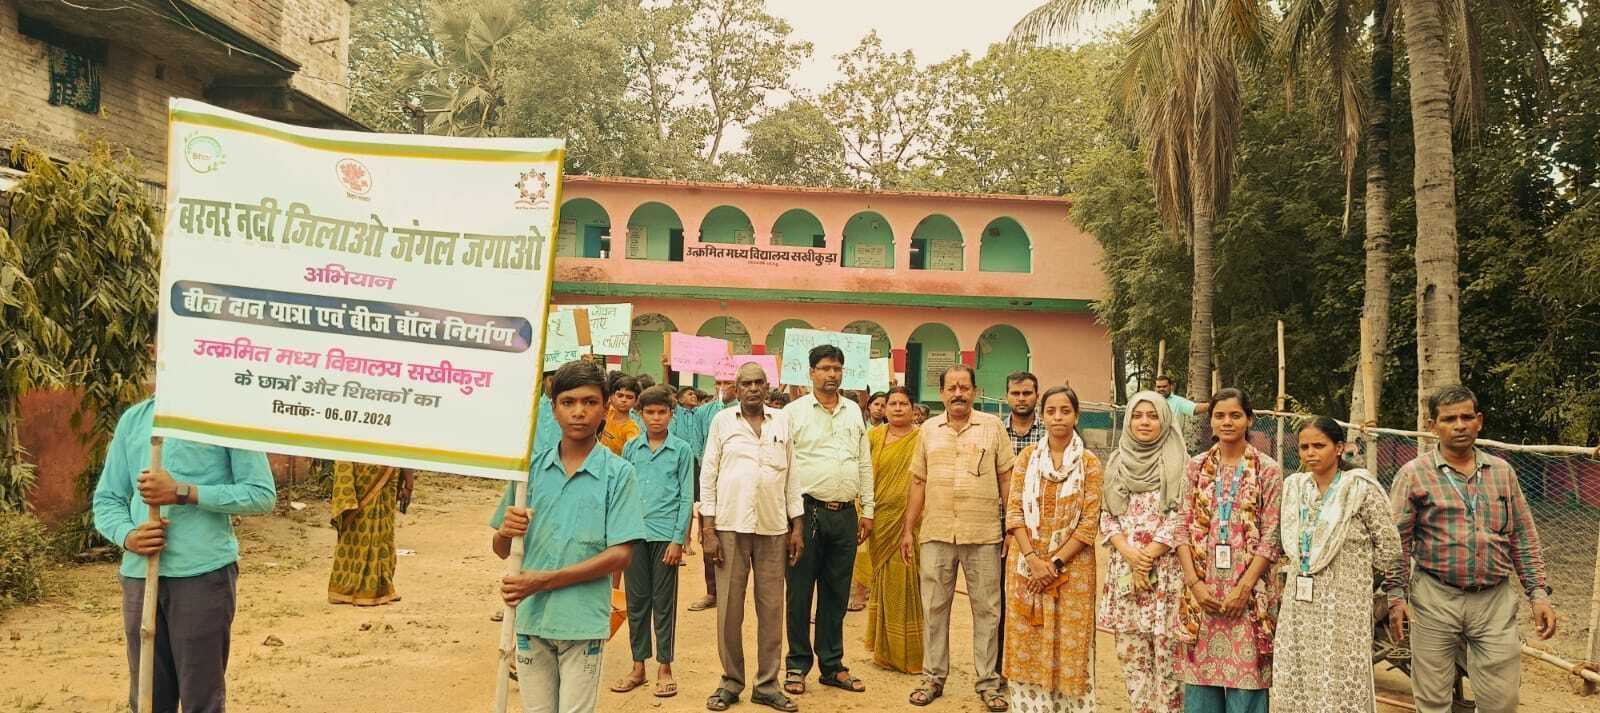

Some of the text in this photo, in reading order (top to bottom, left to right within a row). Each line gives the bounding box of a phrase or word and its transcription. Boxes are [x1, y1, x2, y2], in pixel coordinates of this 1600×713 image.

[179, 198, 231, 237] बरनर
[236, 197, 281, 242] नदी
[283, 203, 389, 257] जिलाओ
[391, 220, 459, 265] जंगल
[462, 226, 545, 270] जगाओ
[686, 245, 724, 258] उत्क्रमित
[726, 248, 748, 259] मध्य
[750, 248, 790, 261] विद्यालय
[304, 264, 397, 290] अभियान
[182, 289, 224, 316] बीज
[229, 299, 265, 320] दान
[269, 300, 311, 325] यात्रा
[316, 303, 344, 330] एवं
[349, 308, 390, 333] बीज
[395, 311, 437, 338] बॉल
[443, 316, 516, 346] निर्माण
[193, 338, 494, 395] उत्क्रमित मध्य विद्यालय सखीकुरा
[234, 372, 441, 409] के छात्रों और शिक्षकों का
[324, 408, 392, 427] 06.07.2024
